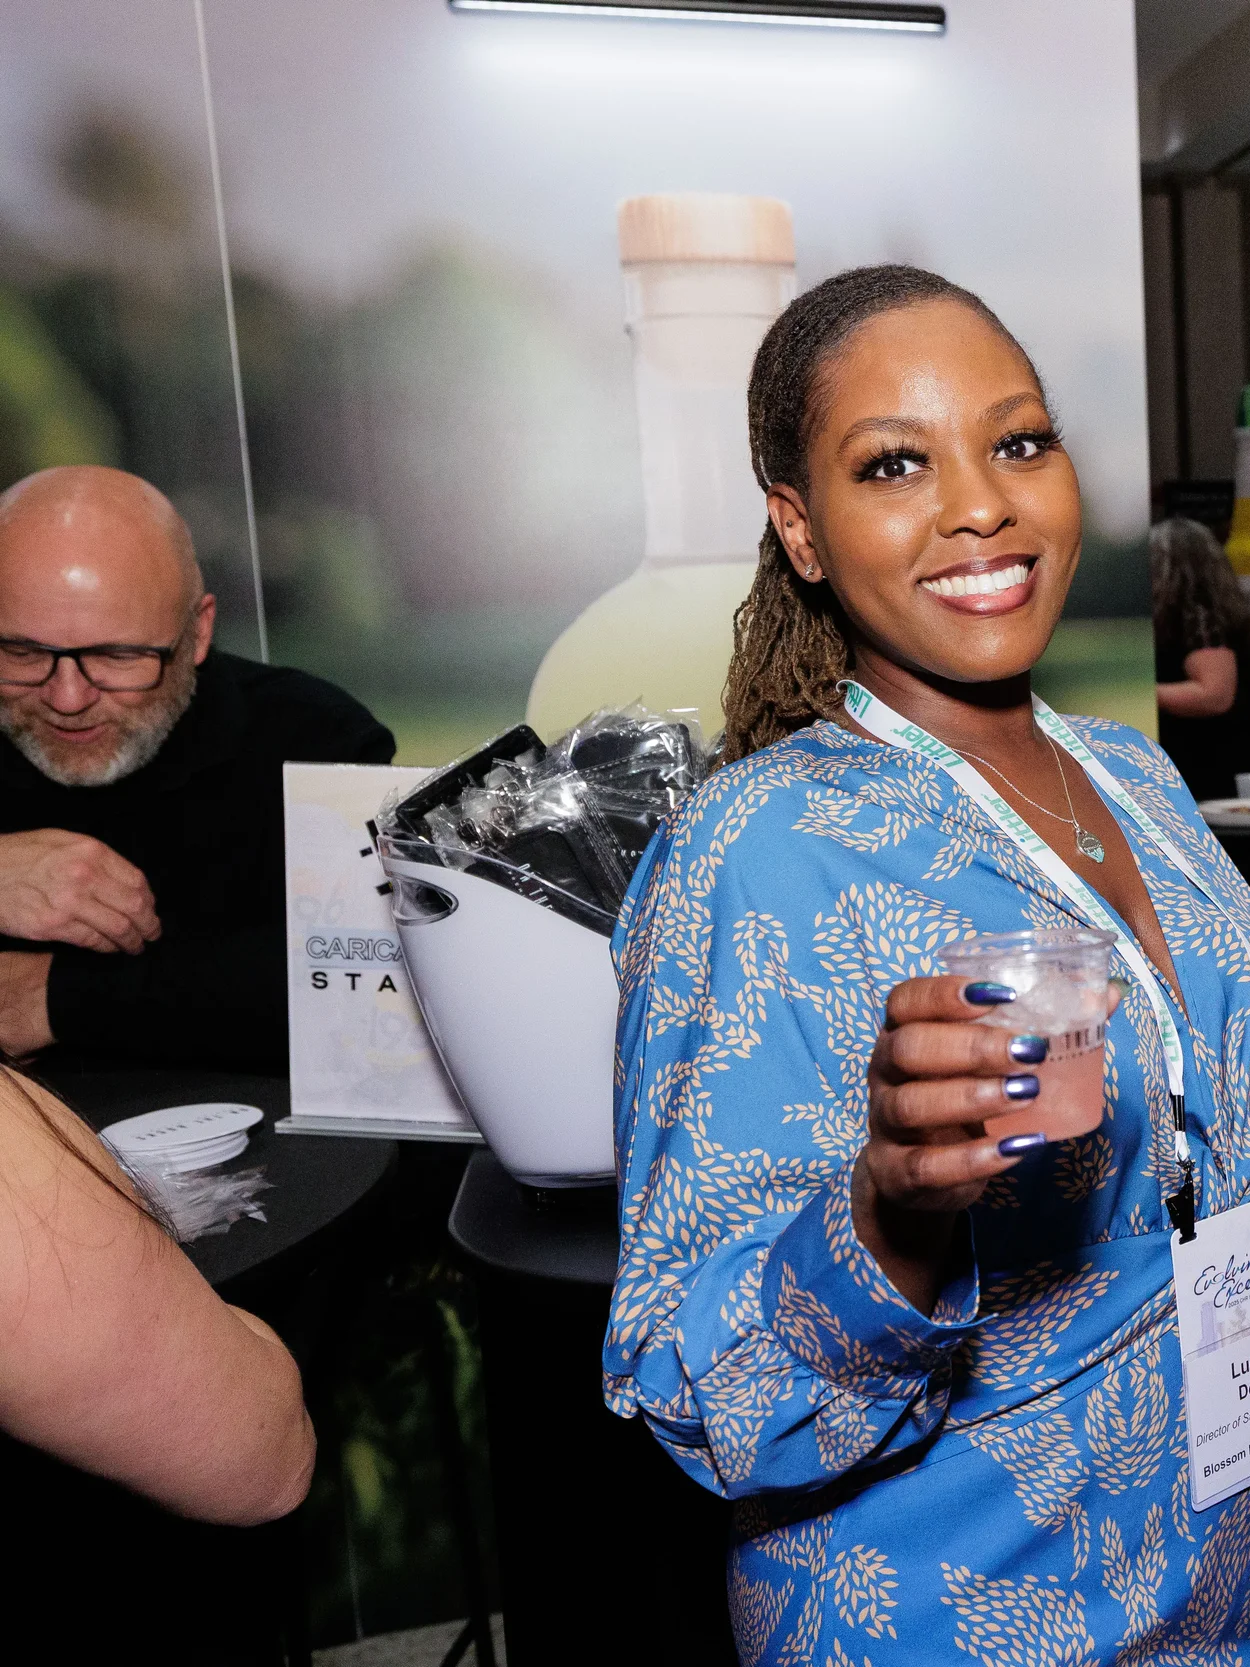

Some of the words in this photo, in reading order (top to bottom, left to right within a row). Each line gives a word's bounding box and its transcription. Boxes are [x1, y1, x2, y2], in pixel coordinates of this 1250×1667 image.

[890, 724, 965, 768] Littler
[1034, 709, 1093, 762] Littler
[982, 793, 1049, 854] Littler
[311, 971, 397, 993] STA
[1196, 1422, 1231, 1448] Director
[1232, 1415, 1242, 1429] of
[1203, 1450, 1246, 1478] Blossom
